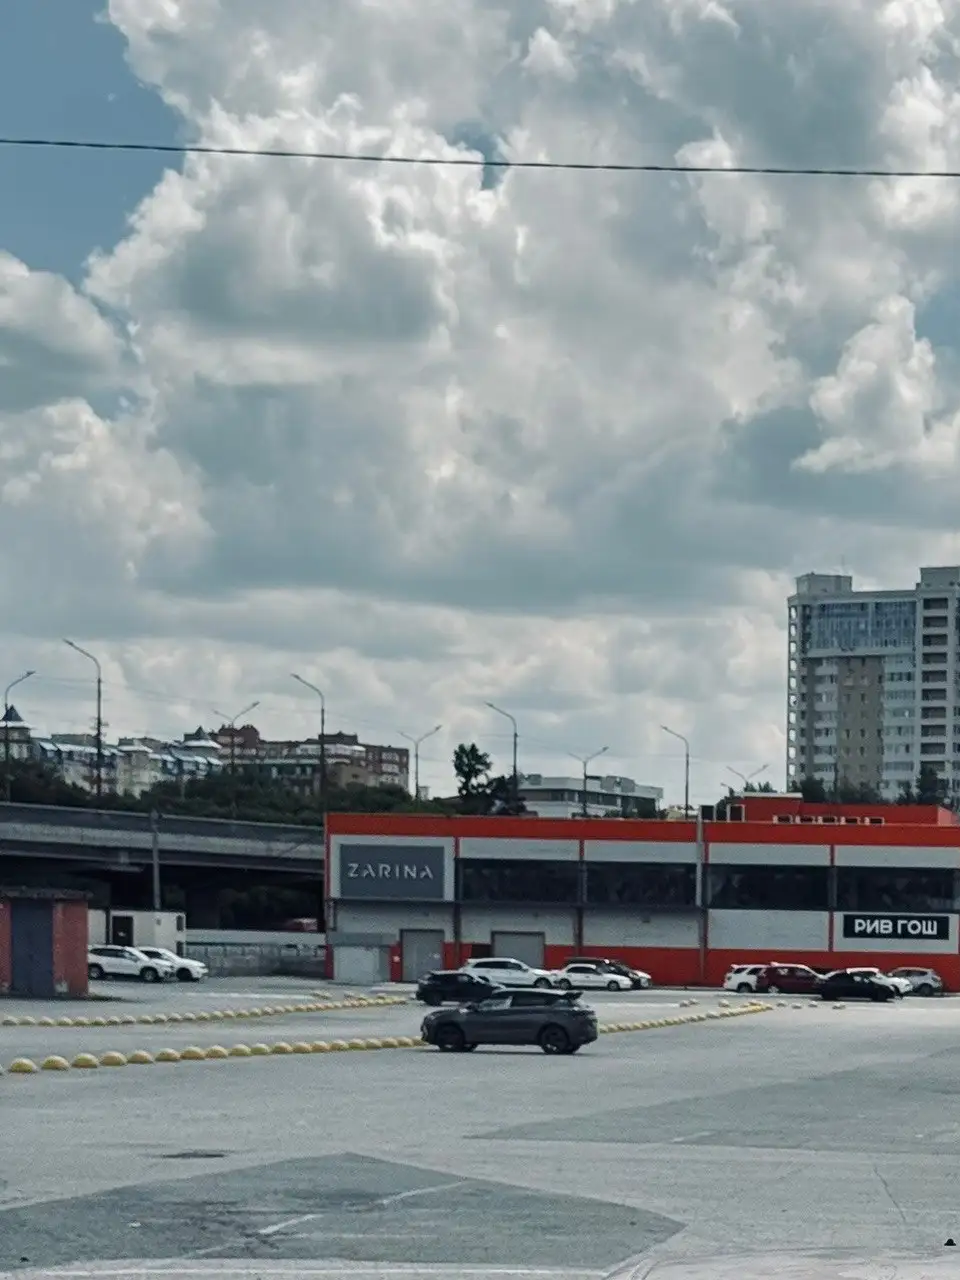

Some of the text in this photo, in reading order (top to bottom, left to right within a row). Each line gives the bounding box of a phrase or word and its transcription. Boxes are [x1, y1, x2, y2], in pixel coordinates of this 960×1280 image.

[347, 863, 434, 879] ZARINA
[854, 919, 938, 935] РИВ ГОШ
